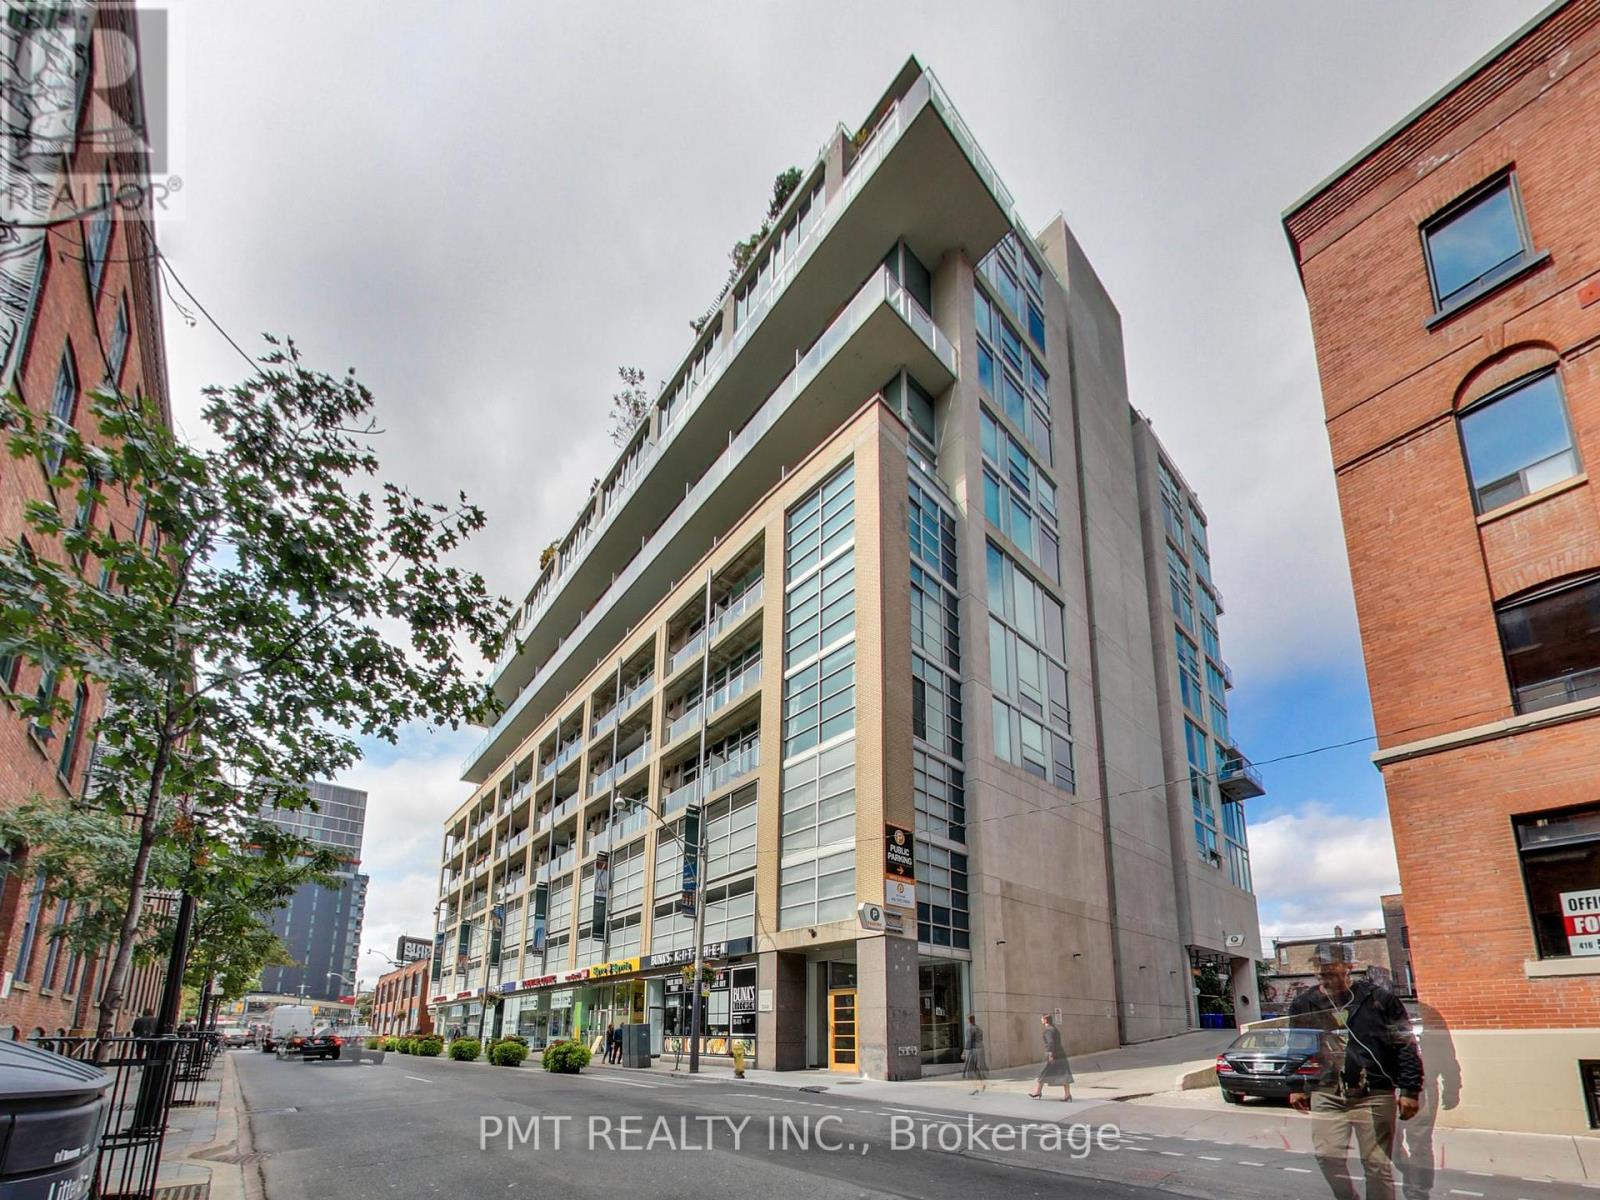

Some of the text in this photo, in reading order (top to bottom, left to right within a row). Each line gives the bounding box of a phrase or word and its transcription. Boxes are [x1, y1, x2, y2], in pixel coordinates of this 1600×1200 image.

[890, 844, 909, 856] PUBLIC
[887, 853, 912, 866] PARKING
[1568, 896, 1600, 911] OFFI
[1573, 915, 1600, 934] FO
[733, 986, 755, 1002] BUNA'S
